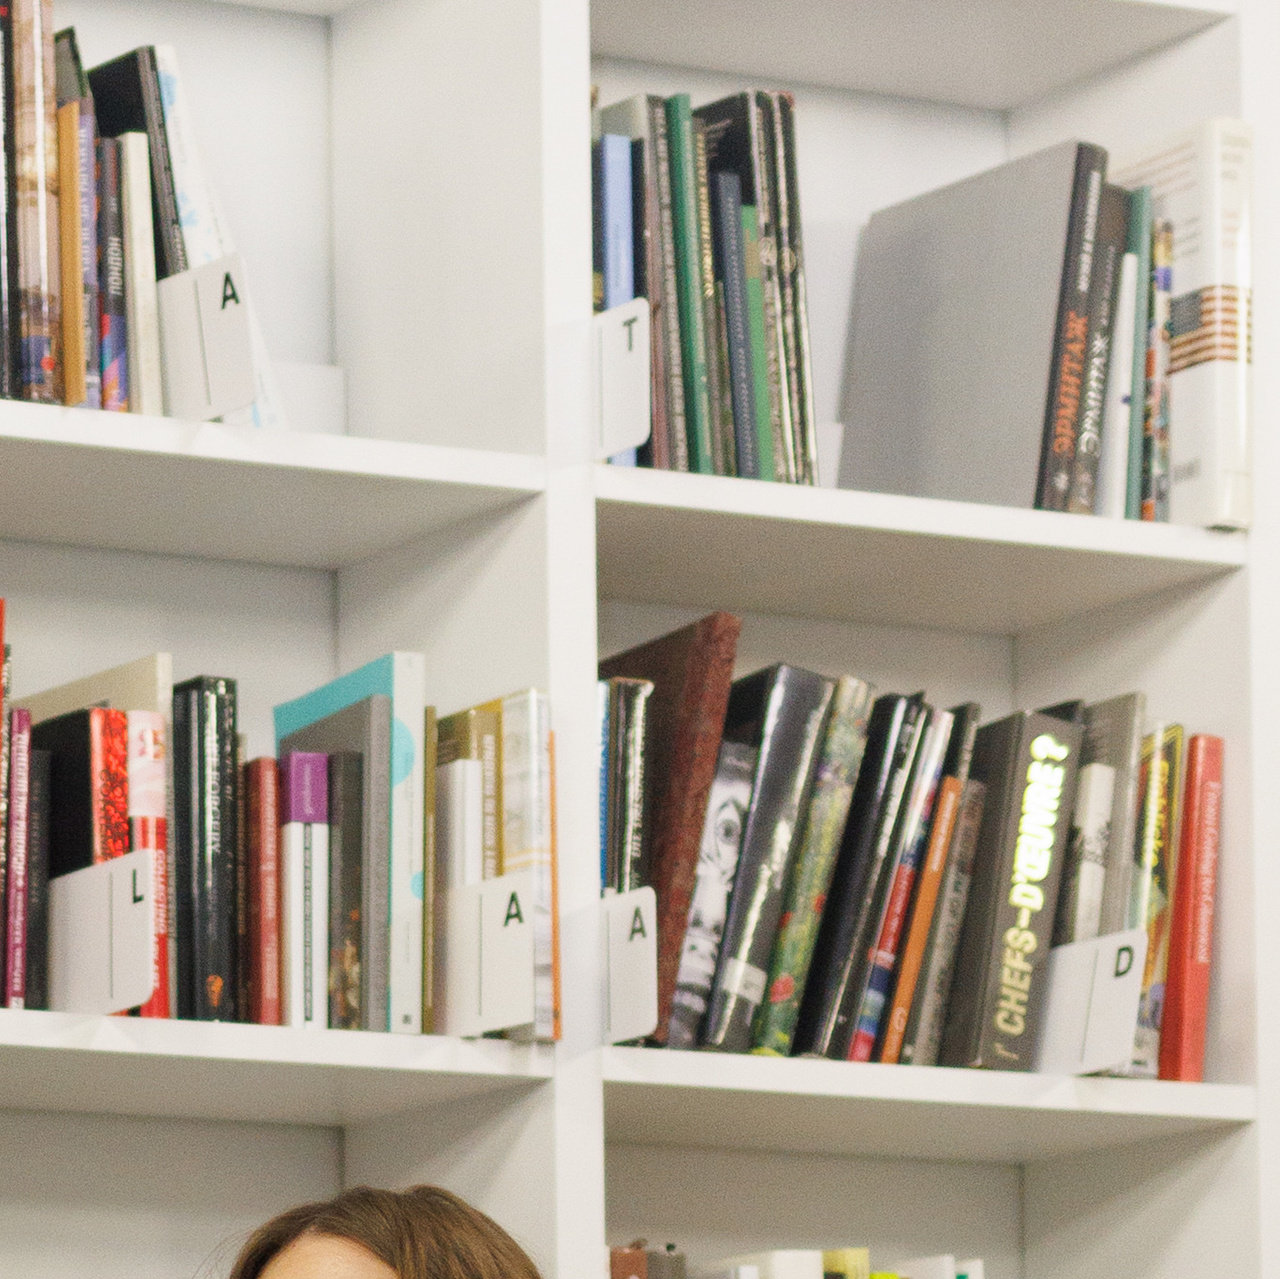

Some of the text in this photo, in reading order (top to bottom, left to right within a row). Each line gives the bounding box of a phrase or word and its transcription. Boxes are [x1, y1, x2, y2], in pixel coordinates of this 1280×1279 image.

[222, 272, 240, 311] A
[622, 316, 638, 352] T
[1054, 311, 1089, 454] ЭРМИТАЖ
[1079, 331, 1110, 455] ЭРМИТАЖ
[1029, 734, 1069, 764] ?
[131, 869, 145, 904] L
[504, 892, 525, 929] A
[626, 905, 648, 943] A
[1113, 945, 1134, 979] D
